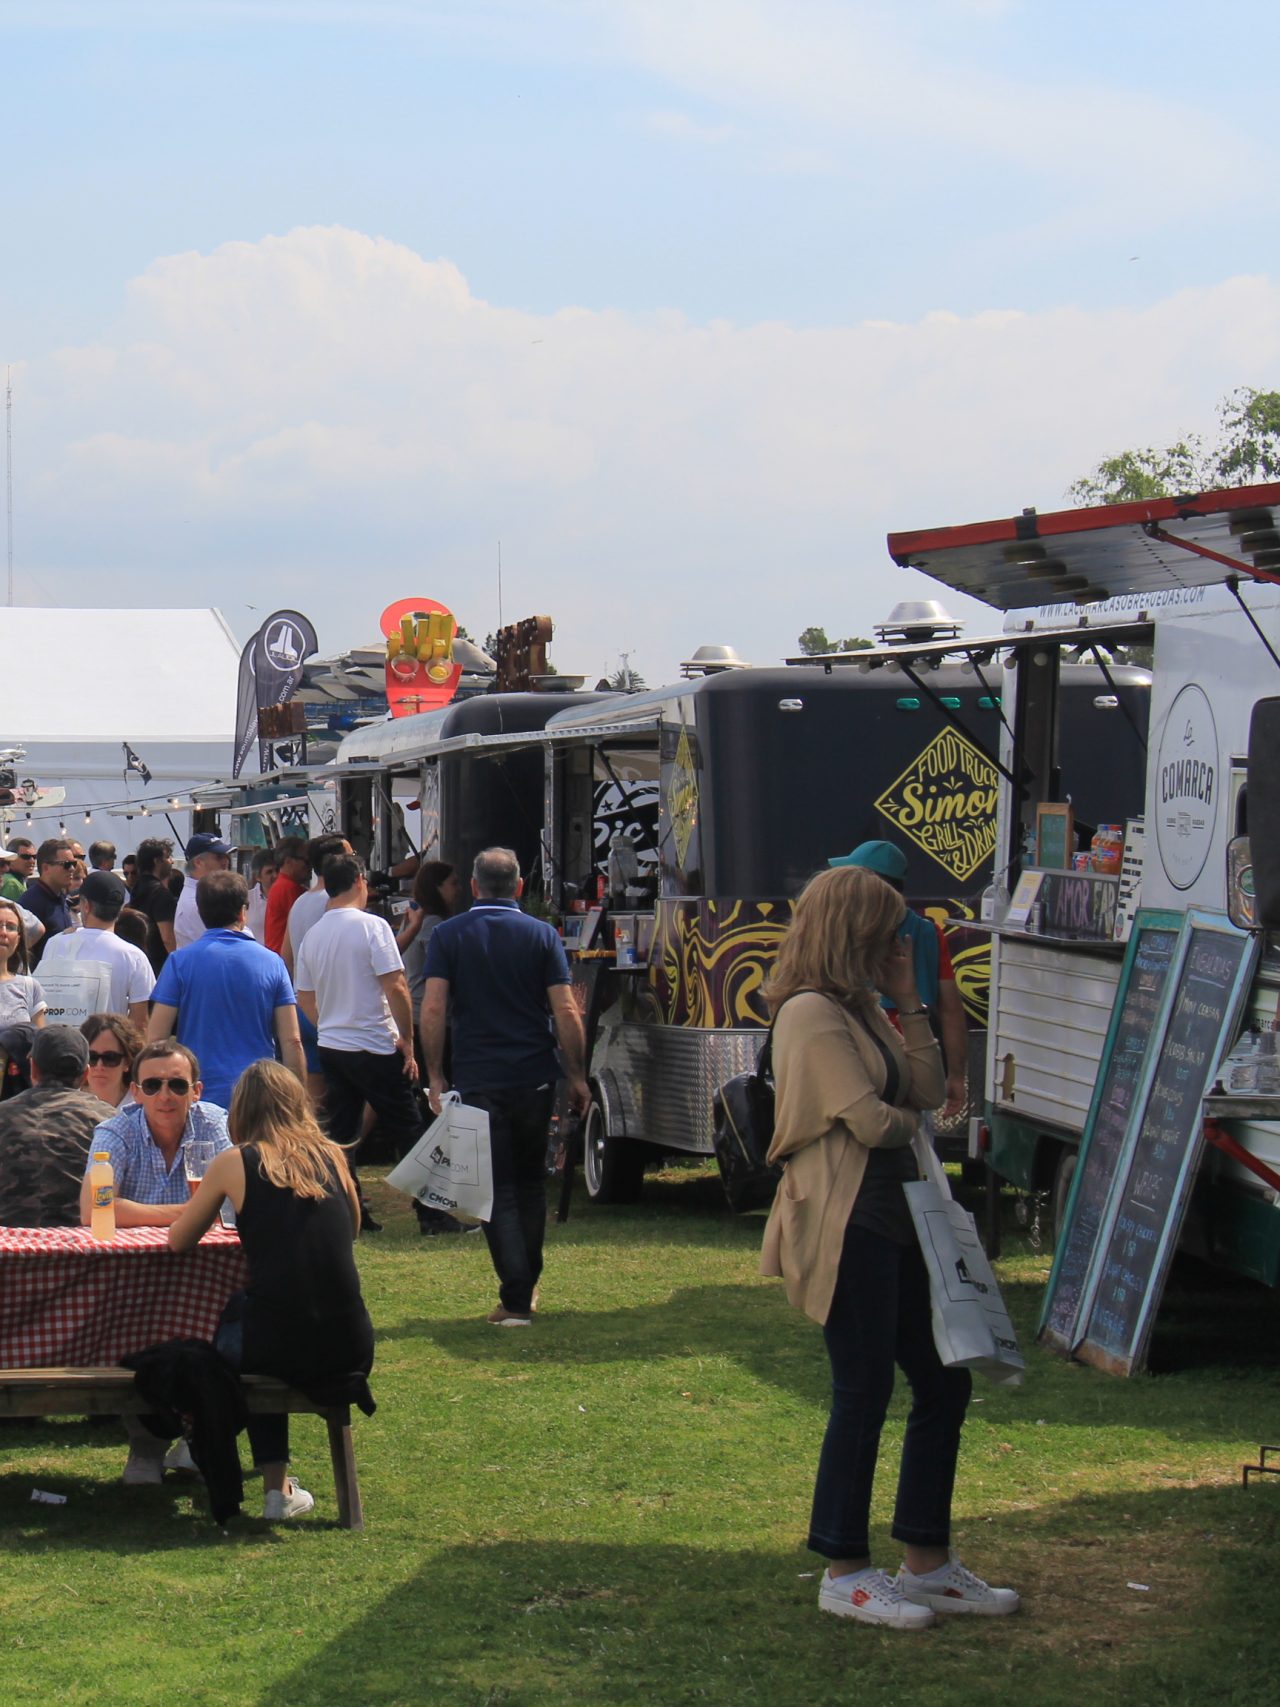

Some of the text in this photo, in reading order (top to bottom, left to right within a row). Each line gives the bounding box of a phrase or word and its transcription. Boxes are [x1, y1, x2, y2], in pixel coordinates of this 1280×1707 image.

[918, 735, 998, 788] FOOD TRUCK
[1162, 759, 1214, 805] COMARCA
